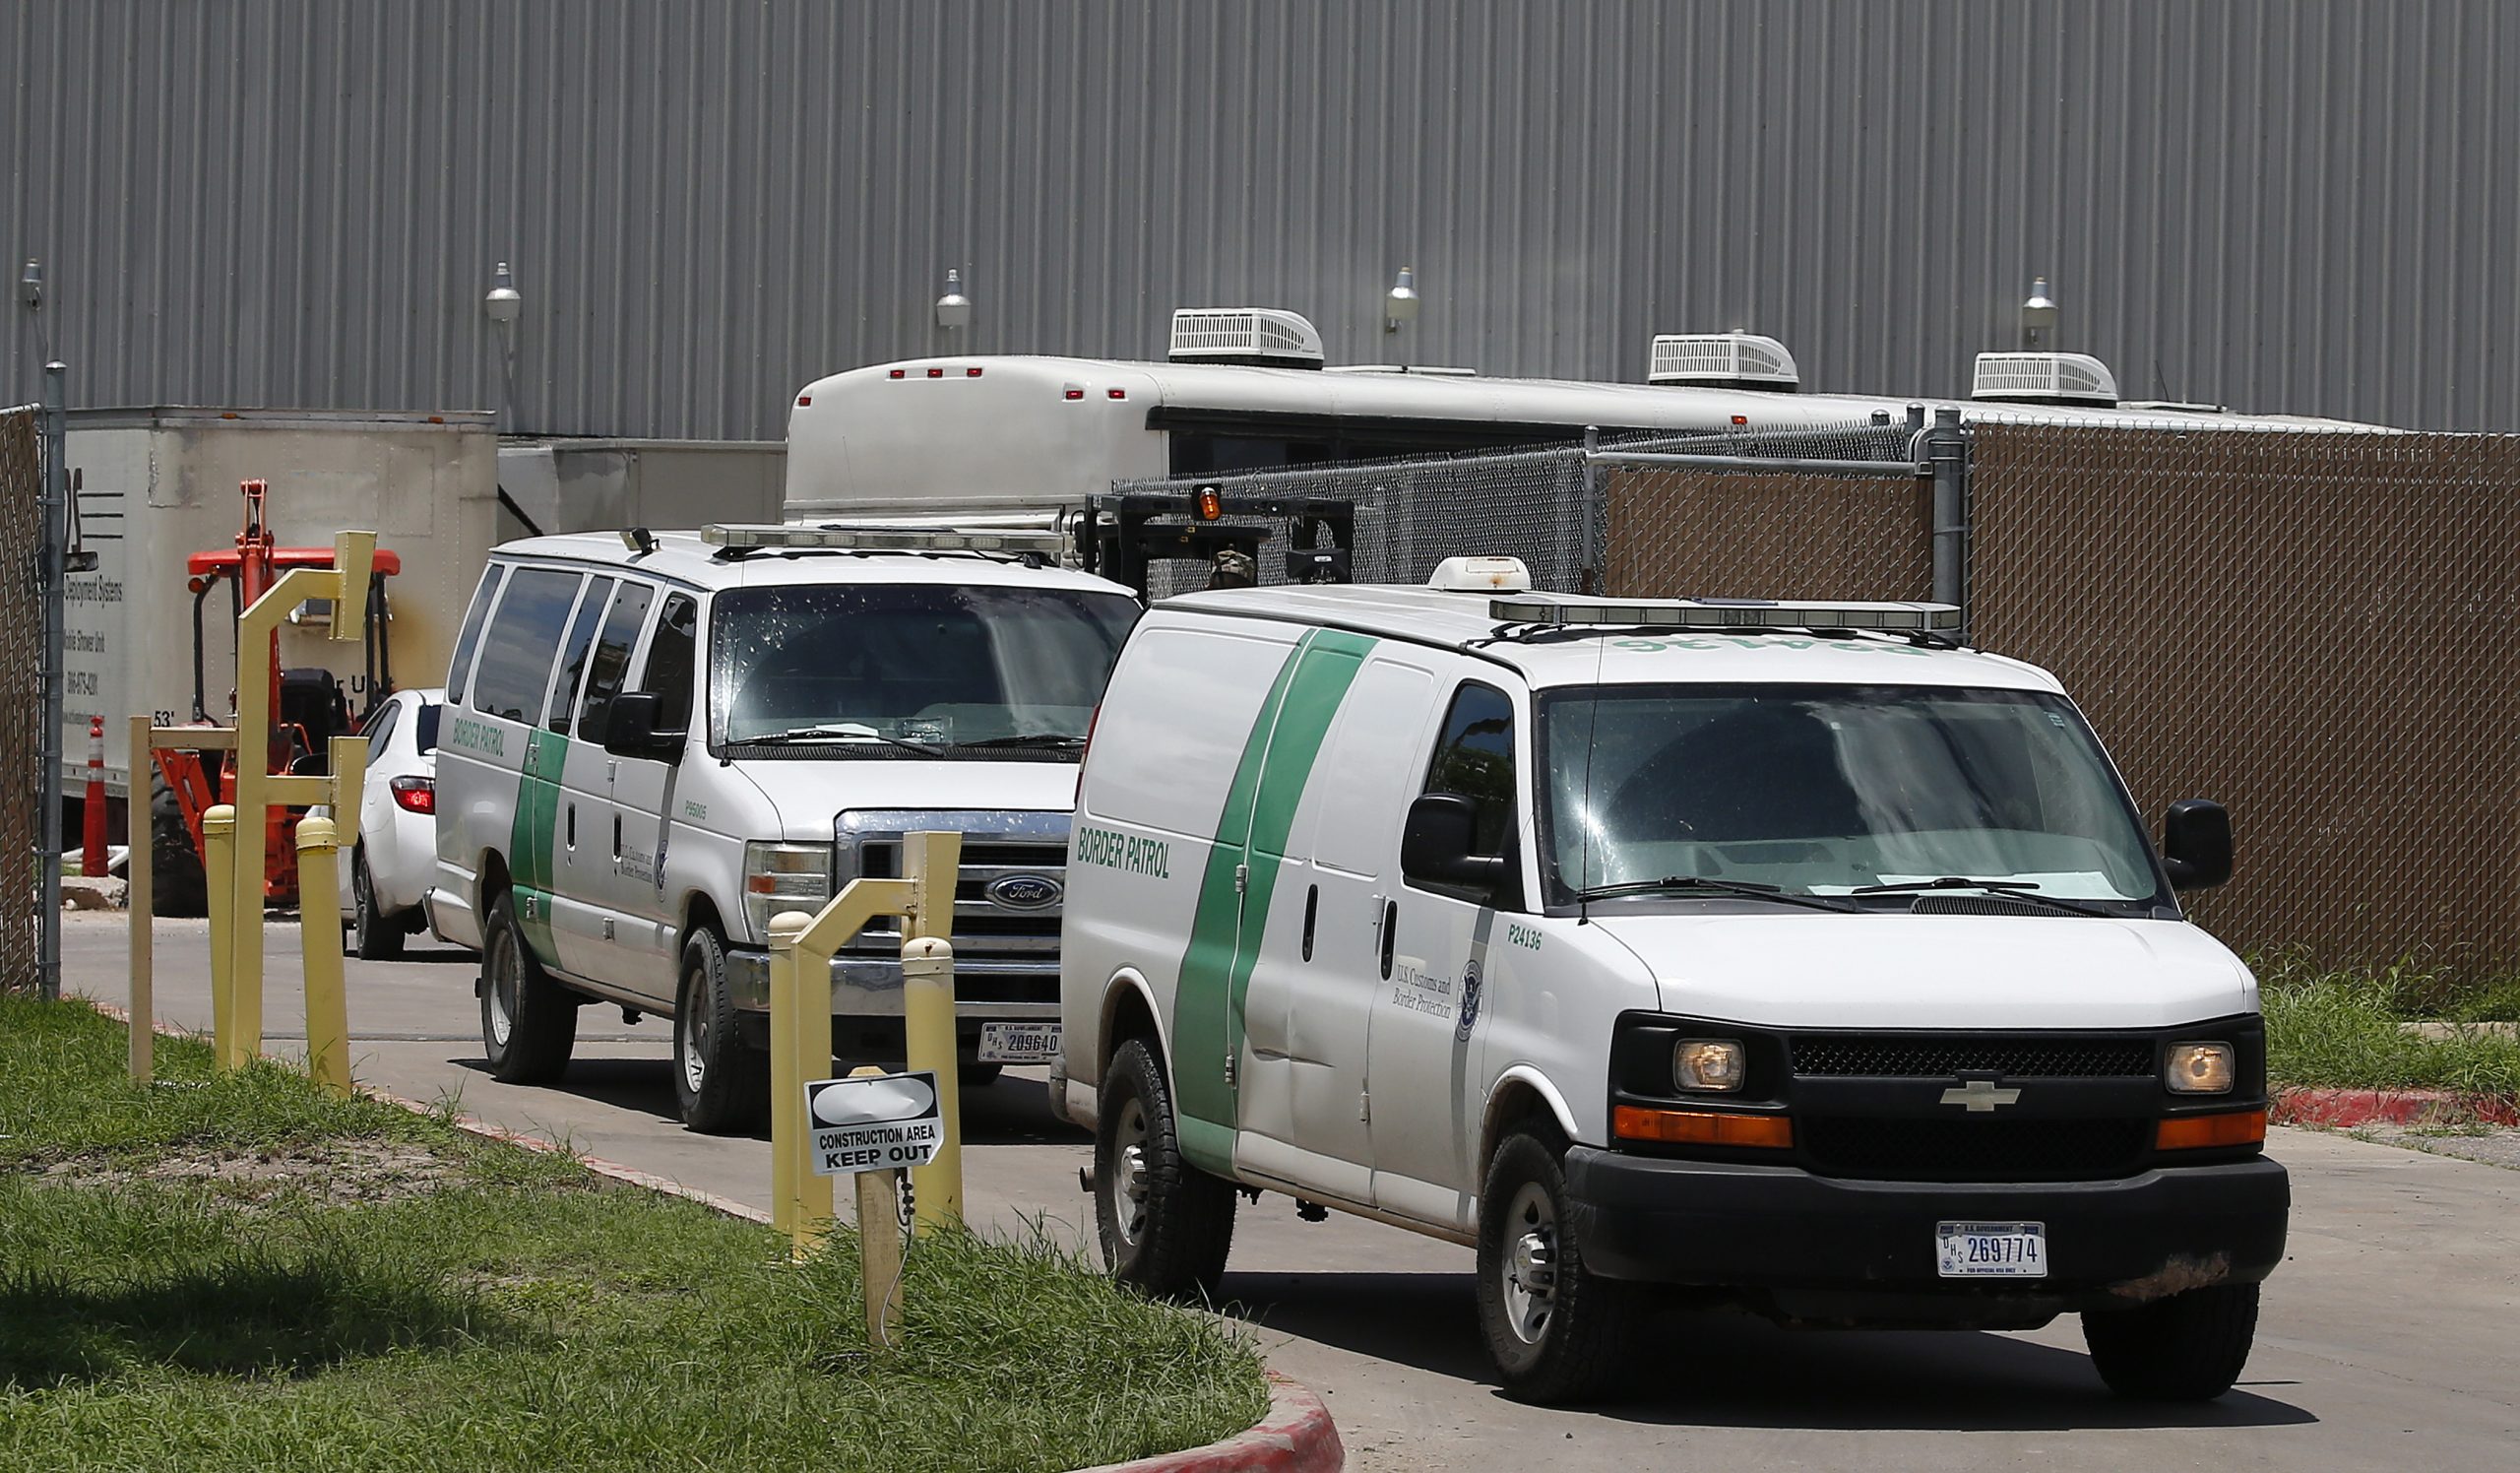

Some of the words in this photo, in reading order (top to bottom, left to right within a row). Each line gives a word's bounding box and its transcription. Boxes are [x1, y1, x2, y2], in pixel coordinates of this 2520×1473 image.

[98, 574, 122, 608] Systems
[154, 711, 174, 727] 53'
[453, 718, 480, 749] BORDER
[480, 725, 504, 757] PATROL
[1078, 827, 1124, 869] BORDER
[1125, 836, 1169, 879] PATROL
[1009, 883, 1042, 899] Ford
[1508, 924, 1543, 951] P24136
[1410, 968, 1437, 992] Customs
[1438, 976, 1451, 994] and
[1393, 988, 1417, 1010] Border
[1416, 993, 1451, 1019] Protection
[819, 1127, 903, 1150] CONSTRUCTION
[907, 1124, 935, 1141] AREA
[825, 1149, 881, 1169] KEEP
[888, 1145, 932, 1162] OUT
[1968, 1238, 2038, 1262] 269774
